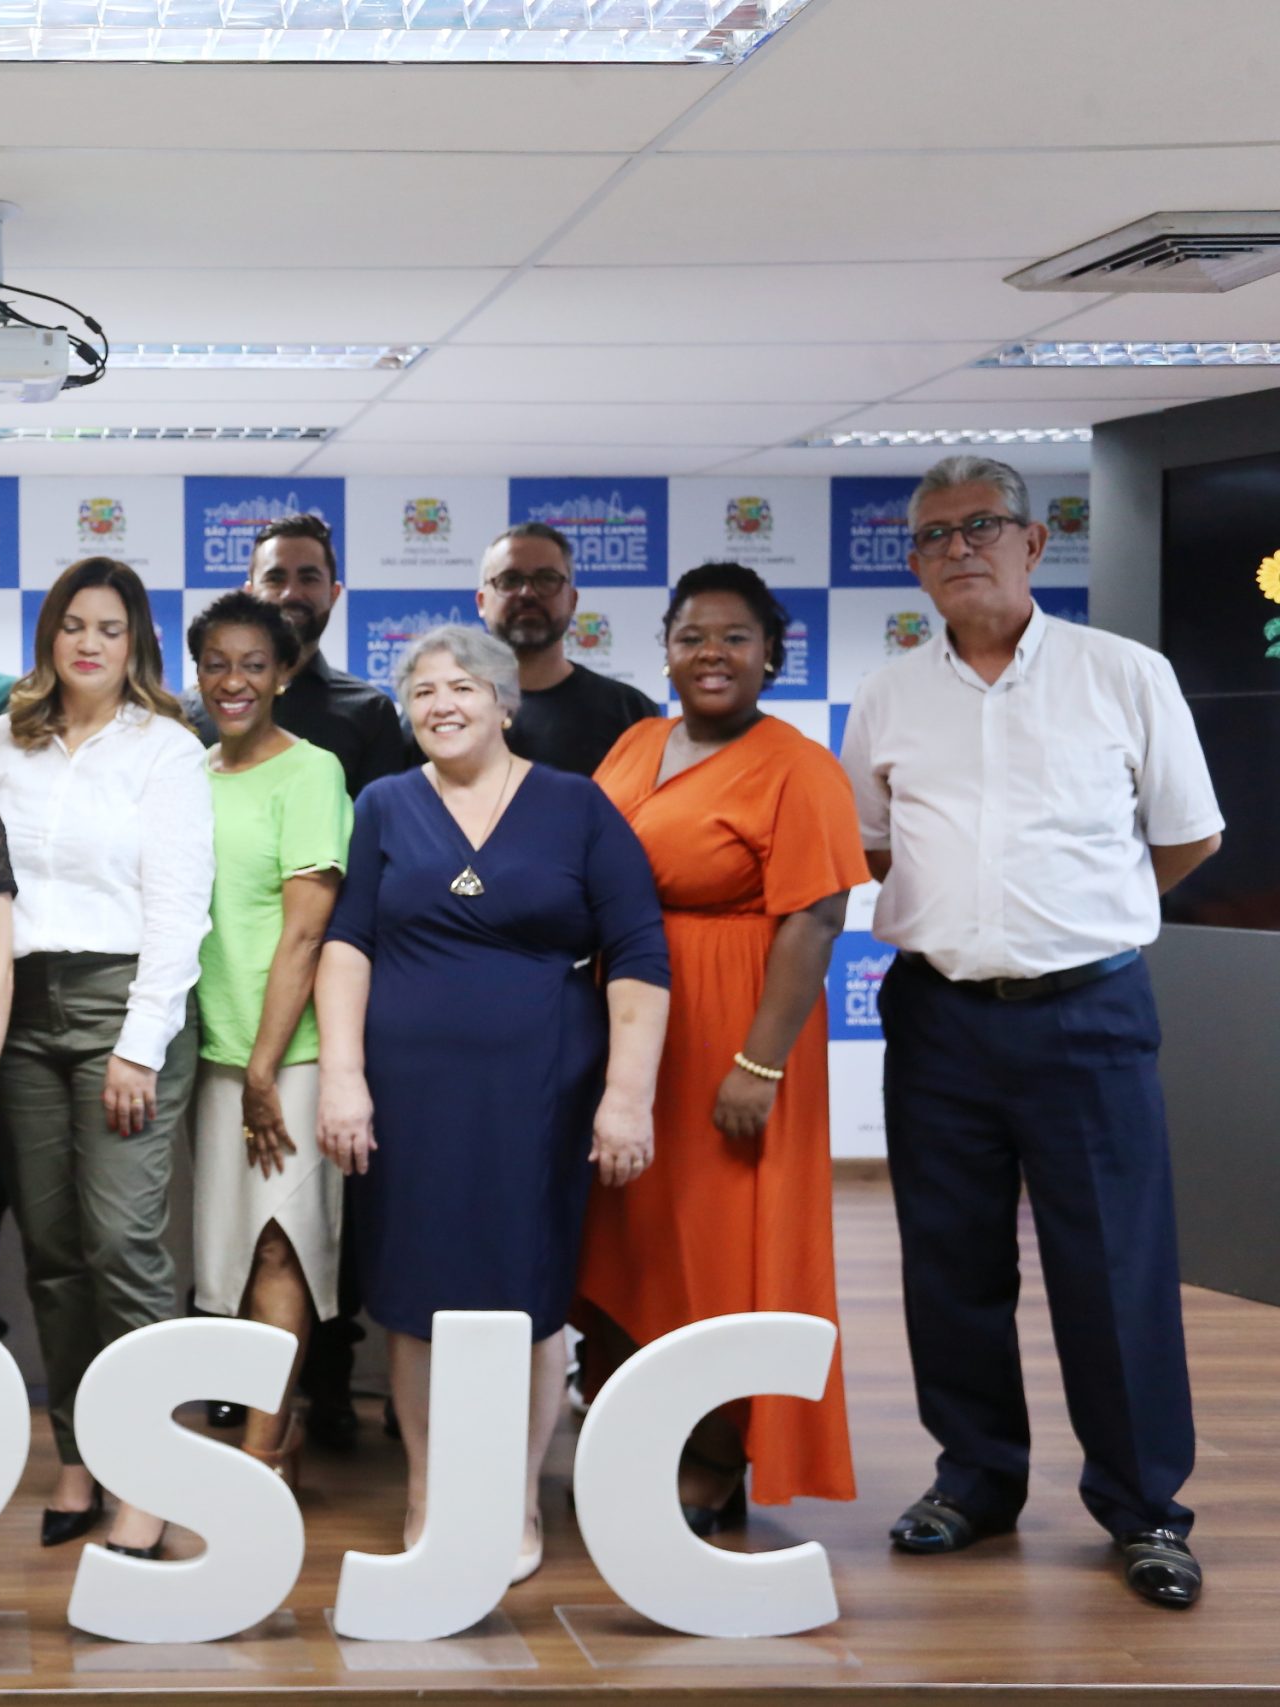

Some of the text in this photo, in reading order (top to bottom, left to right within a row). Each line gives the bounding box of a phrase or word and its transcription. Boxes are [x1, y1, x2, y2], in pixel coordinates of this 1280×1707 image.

[204, 525, 227, 537] SÃO
[603, 526, 647, 537] CAMPOS
[67, 1310, 839, 1645] SJC
